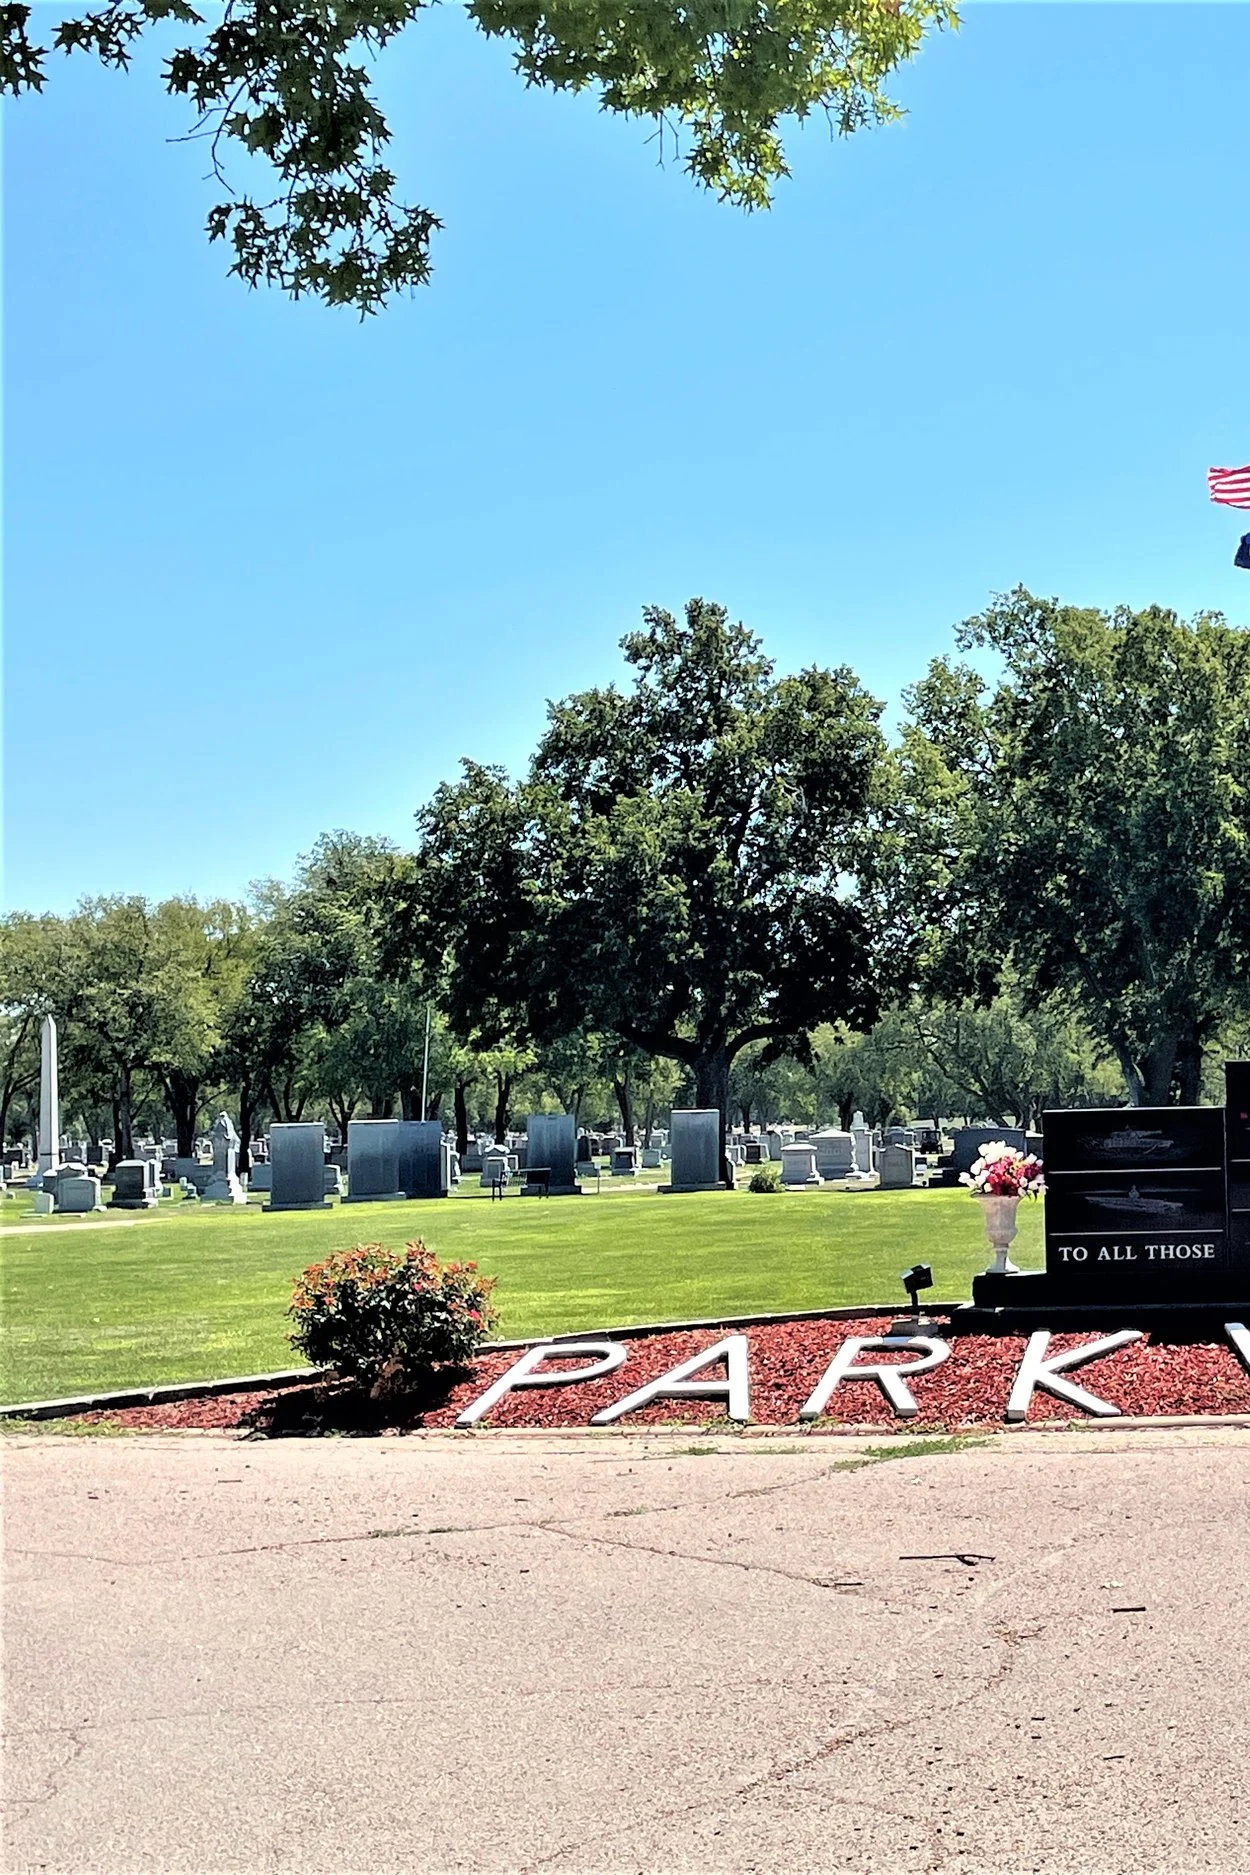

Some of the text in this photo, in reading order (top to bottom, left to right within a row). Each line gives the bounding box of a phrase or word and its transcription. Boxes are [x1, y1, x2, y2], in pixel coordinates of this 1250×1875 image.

[1058, 1244, 1215, 1261] TO ALL THOSE
